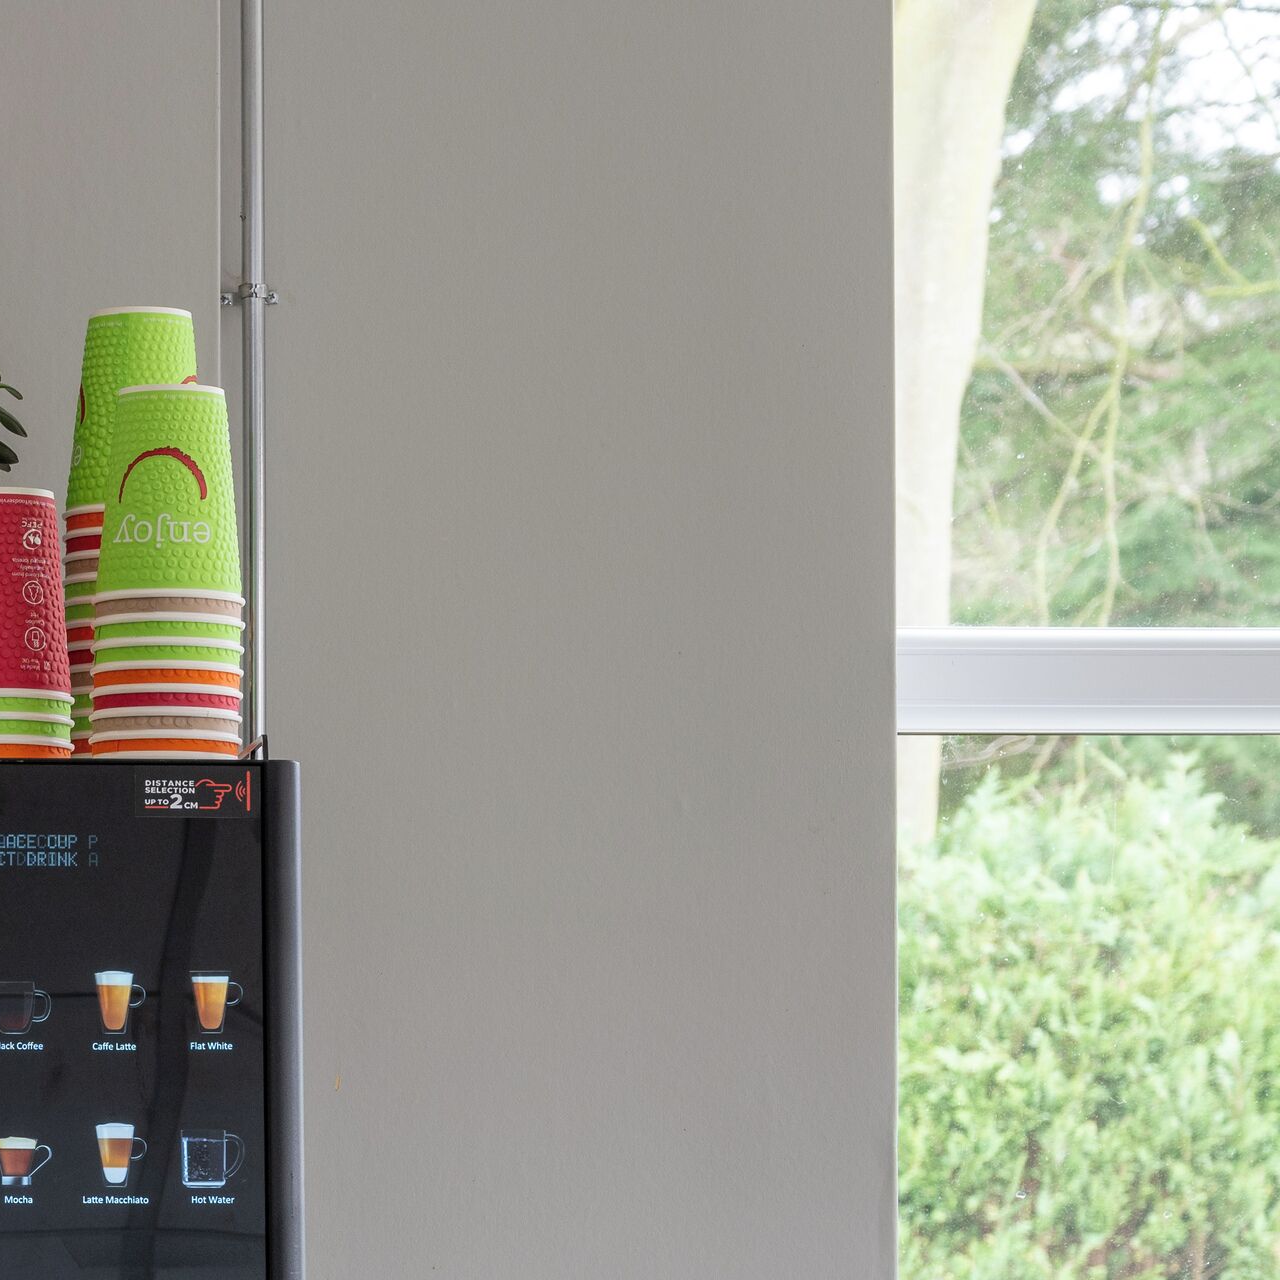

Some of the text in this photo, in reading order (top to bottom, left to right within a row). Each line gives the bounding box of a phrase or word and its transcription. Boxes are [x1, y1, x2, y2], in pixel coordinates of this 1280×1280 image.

[112, 513, 211, 549] enjoy
[170, 794, 182, 809] 2
[16, 1042, 44, 1050] Coffee
[92, 1042, 114, 1050] Caffe
[190, 1042, 233, 1050] Flat White
[4, 1195, 33, 1204] Mocha
[82, 1196, 149, 1204] Latte Macchiato
[191, 1196, 235, 1204] Hot Water
